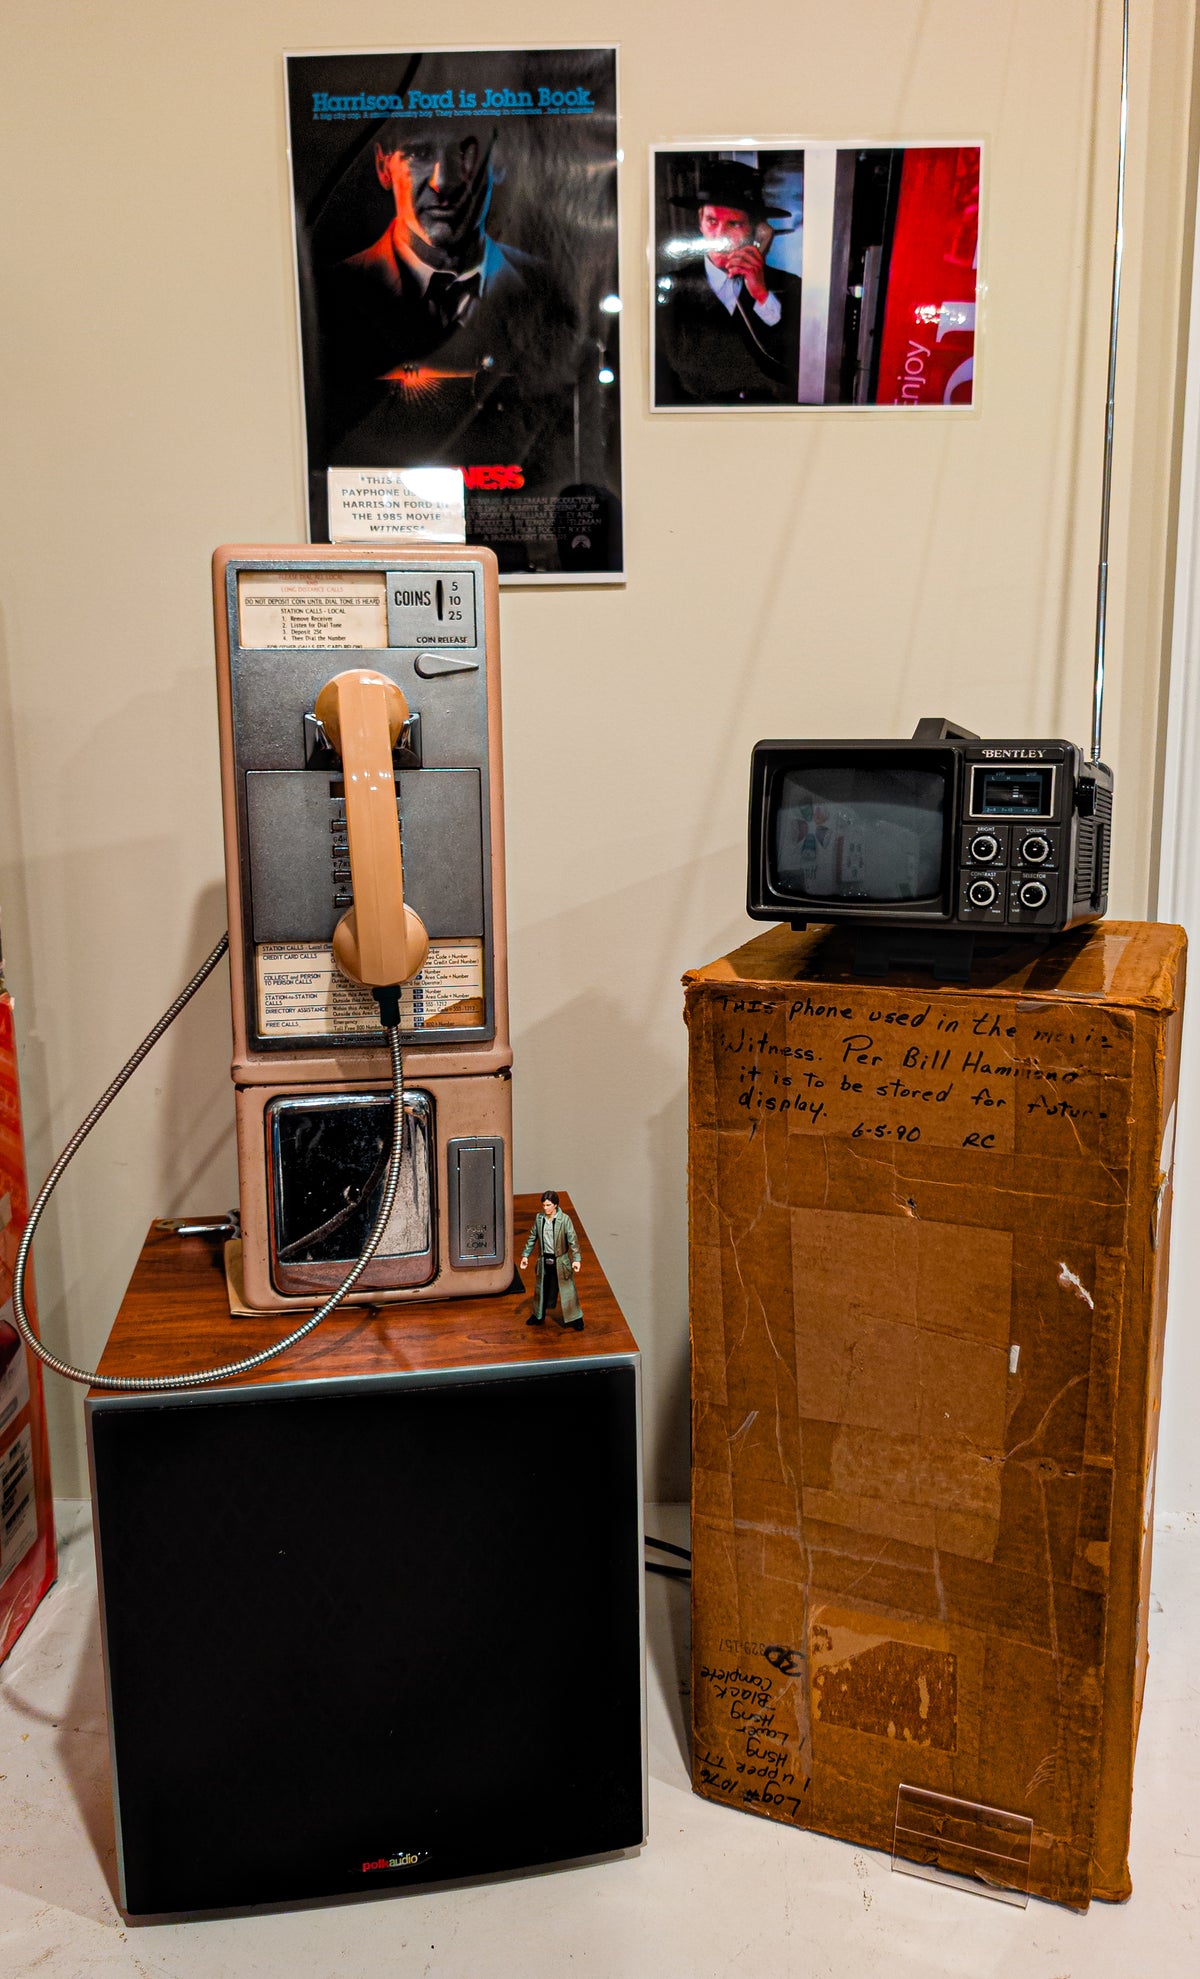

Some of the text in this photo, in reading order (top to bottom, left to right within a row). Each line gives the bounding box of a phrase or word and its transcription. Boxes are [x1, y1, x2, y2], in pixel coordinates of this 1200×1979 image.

[312, 86, 595, 112] Harrison Ford is John Book.
[894, 340, 931, 405] njoy
[461, 465, 525, 490] NESS
[342, 488, 400, 497] PAYPHONE
[343, 500, 400, 509] HARRISON
[404, 500, 433, 509] FORD
[352, 512, 441, 521] THE 1985 MOVIE
[452, 581, 459, 592] 5
[395, 590, 431, 607] COINS
[449, 595, 462, 606] 10
[448, 610, 463, 621] 25
[416, 636, 468, 644] COIN RELEASE
[982, 749, 1046, 758] BENTLEY
[265, 1007, 296, 1015] DIRECTORY
[789, 997, 853, 1022] phone
[869, 1004, 931, 1028] used
[937, 1013, 959, 1033] in
[973, 1012, 1018, 1038] the
[281, 1020, 299, 1028] CALLS
[842, 1034, 882, 1066] Per
[903, 1046, 951, 1071] Bill
[740, 1065, 761, 1083] it
[773, 1070, 792, 1087] is
[840, 1074, 863, 1093] be
[876, 1078, 954, 1102] stored
[971, 1088, 1007, 1108] for
[738, 1085, 828, 1124] display.
[962, 1132, 996, 1149] RC
[700, 1665, 773, 1692] Complete
[713, 1684, 773, 1708] Black
[362, 1853, 418, 1873] polkaudio
